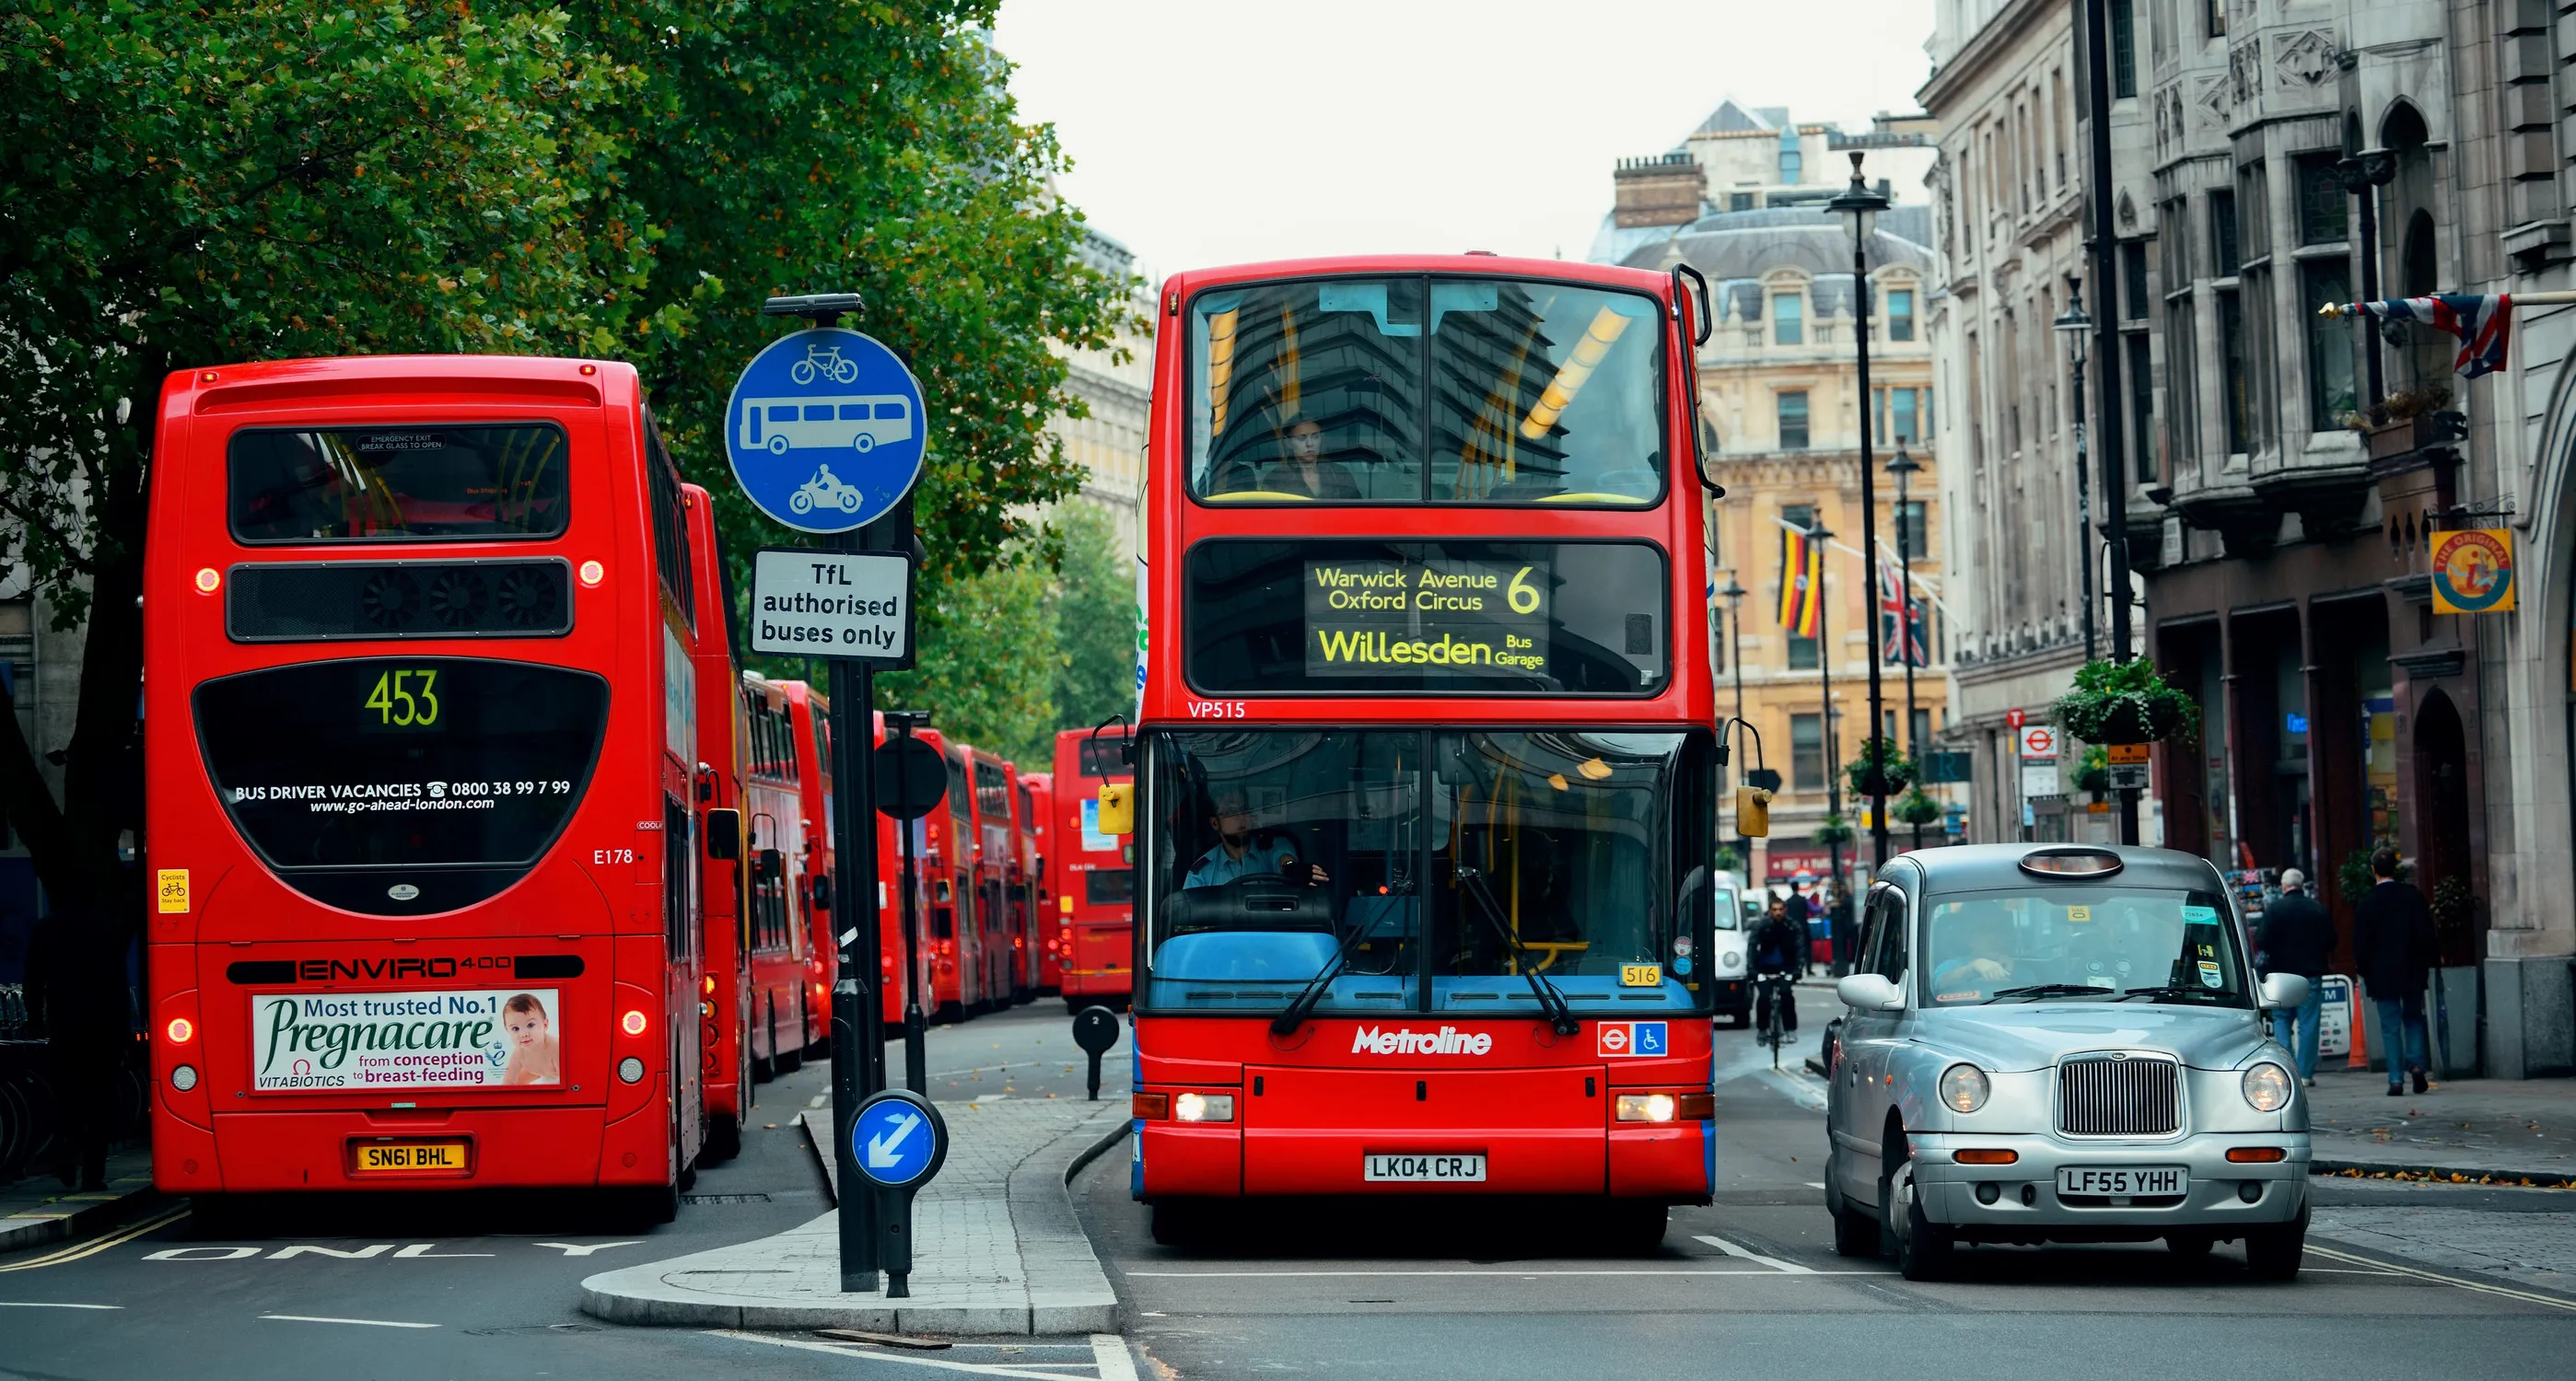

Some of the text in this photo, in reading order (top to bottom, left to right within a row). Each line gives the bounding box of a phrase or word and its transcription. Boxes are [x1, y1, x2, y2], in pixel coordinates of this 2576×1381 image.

[2436, 543, 2454, 567] THE
[811, 563, 852, 586] TfL
[1315, 568, 1497, 589] Warwick Avenue
[1329, 590, 1482, 610] Oxford Circus
[1508, 566, 1540, 614] 6
[763, 592, 897, 617] authorised
[762, 620, 896, 650] buses only
[1507, 634, 1532, 649] Bus
[1319, 630, 1491, 666] Willesden
[1495, 652, 1544, 669] Garage
[365, 669, 438, 726] 453
[1187, 702, 1245, 718] VP515
[236, 781, 570, 800] BUS DRIVER VACANCIES 0800 38 99 7 99
[310, 798, 495, 814] www.go-ahead-london.com
[594, 849, 633, 864] E178
[299, 957, 511, 981] ENVIRO 400
[1626, 968, 1656, 982] 516
[304, 996, 497, 1017] Most trusted No.1
[1092, 1016, 1101, 1026] 2
[1351, 1026, 1492, 1055] Metroline
[359, 1052, 484, 1068] from conception
[259, 1075, 344, 1088] VITABIOTICS
[353, 1072, 364, 1081] to
[365, 1067, 484, 1085] breast-feeding
[368, 1148, 452, 1166] SN61 BHL
[1373, 1157, 1477, 1177] LK04 CRJ
[2068, 1171, 2177, 1191] LF55 YHH
[141, 1240, 647, 1260] ONLY
